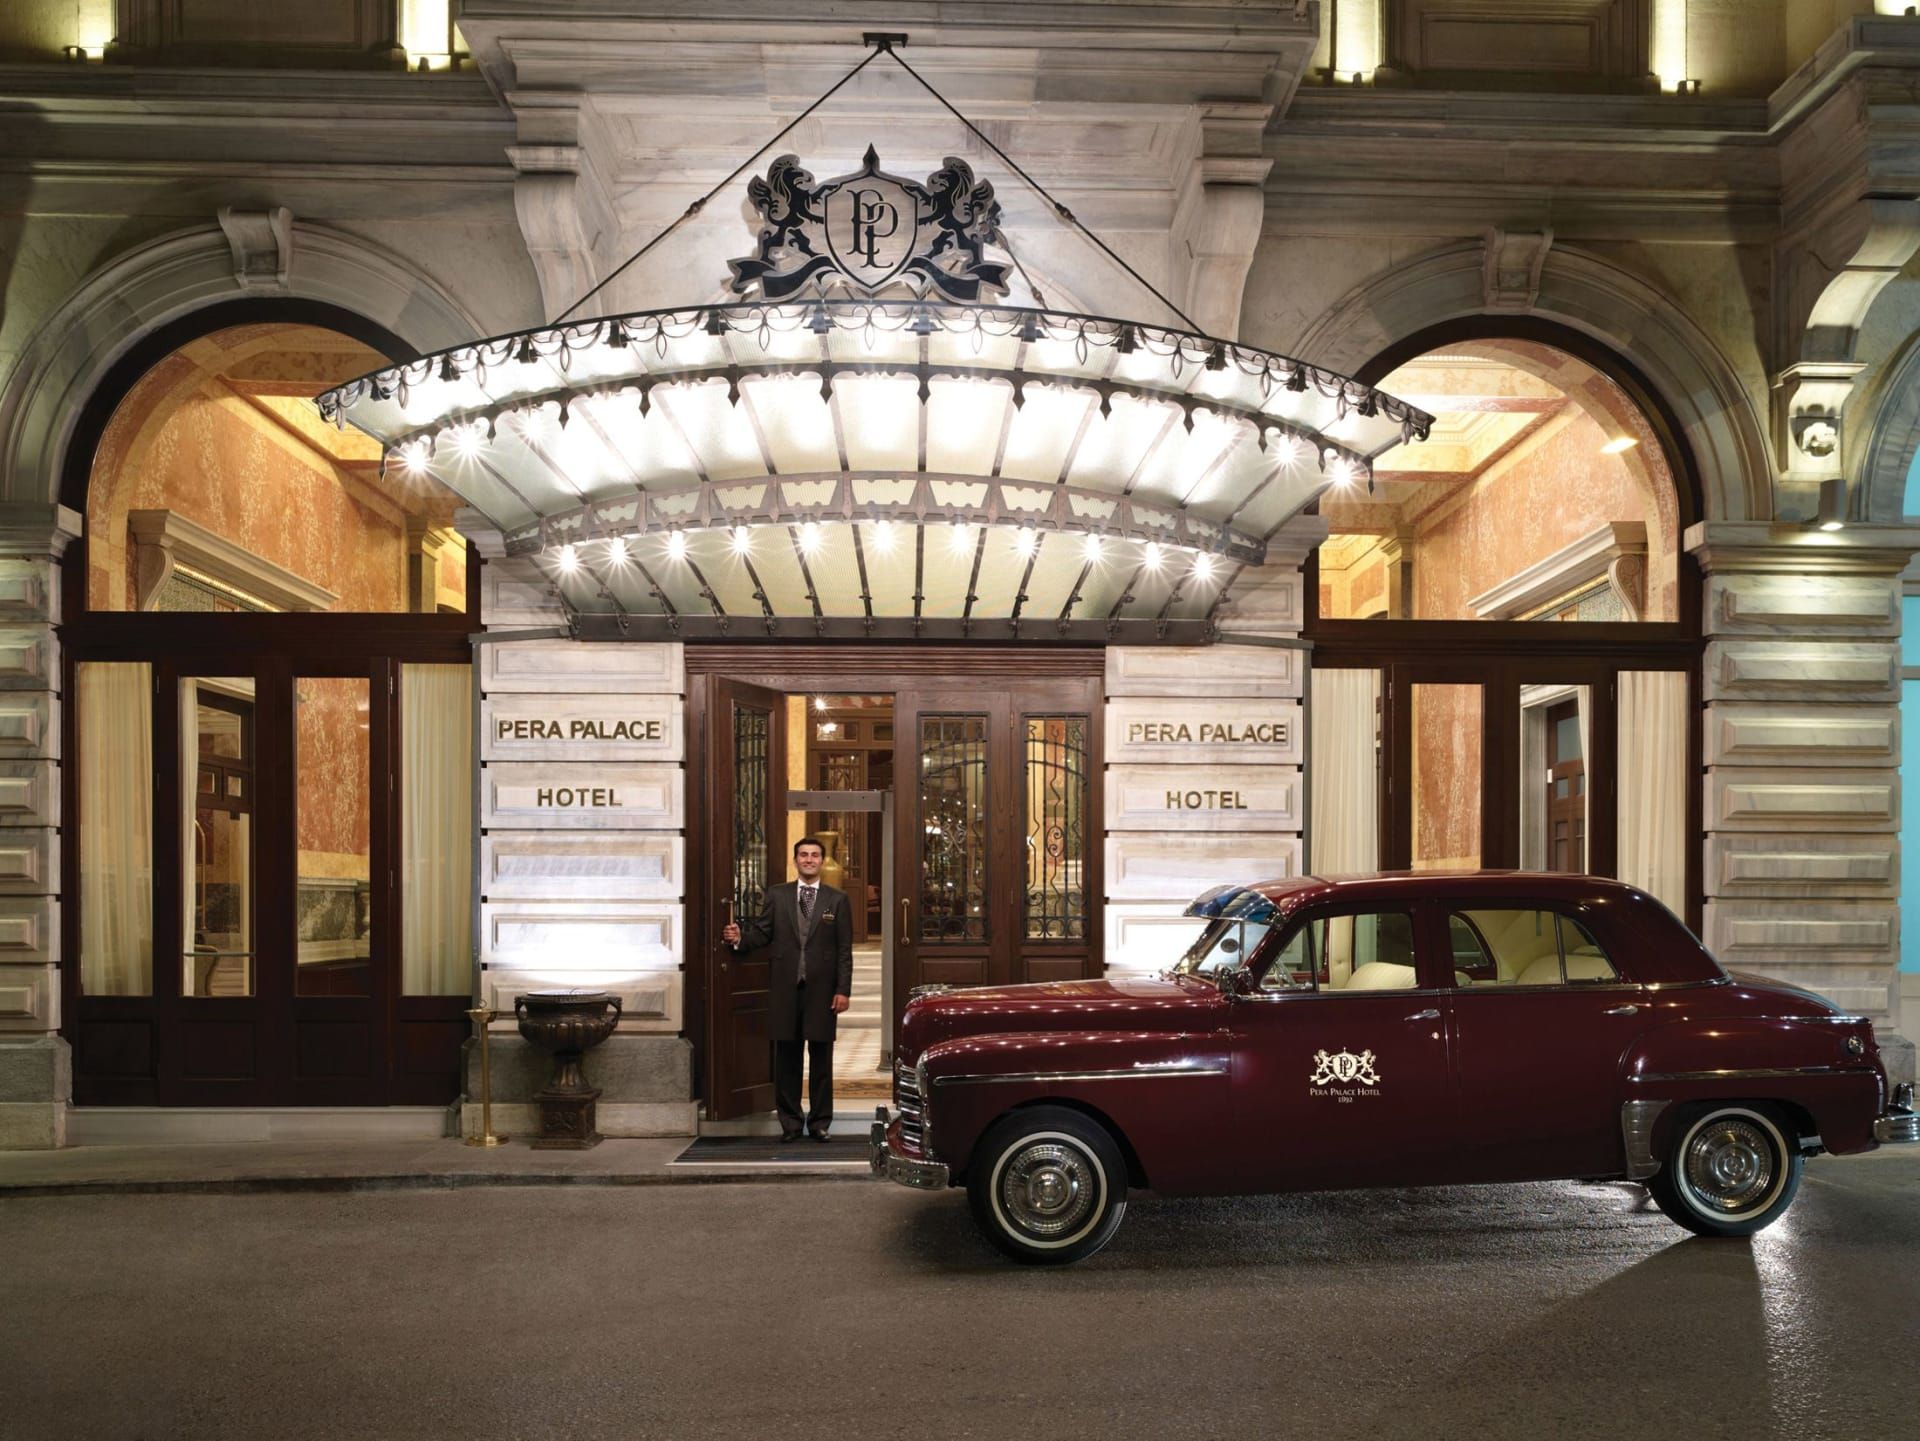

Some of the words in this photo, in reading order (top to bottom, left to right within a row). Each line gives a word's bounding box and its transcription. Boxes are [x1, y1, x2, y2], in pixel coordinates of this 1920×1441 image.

[499, 720, 563, 739] PERA
[570, 720, 661, 740] PALACE
[1129, 723, 1192, 742] PERA
[1200, 723, 1287, 743] PALACE
[537, 788, 622, 807] HOTEL
[1166, 791, 1247, 810] HOTEL
[1309, 1087, 1328, 1096] PERA
[1330, 1087, 1356, 1096] PALACE
[1358, 1087, 1381, 1096] HOTEL
